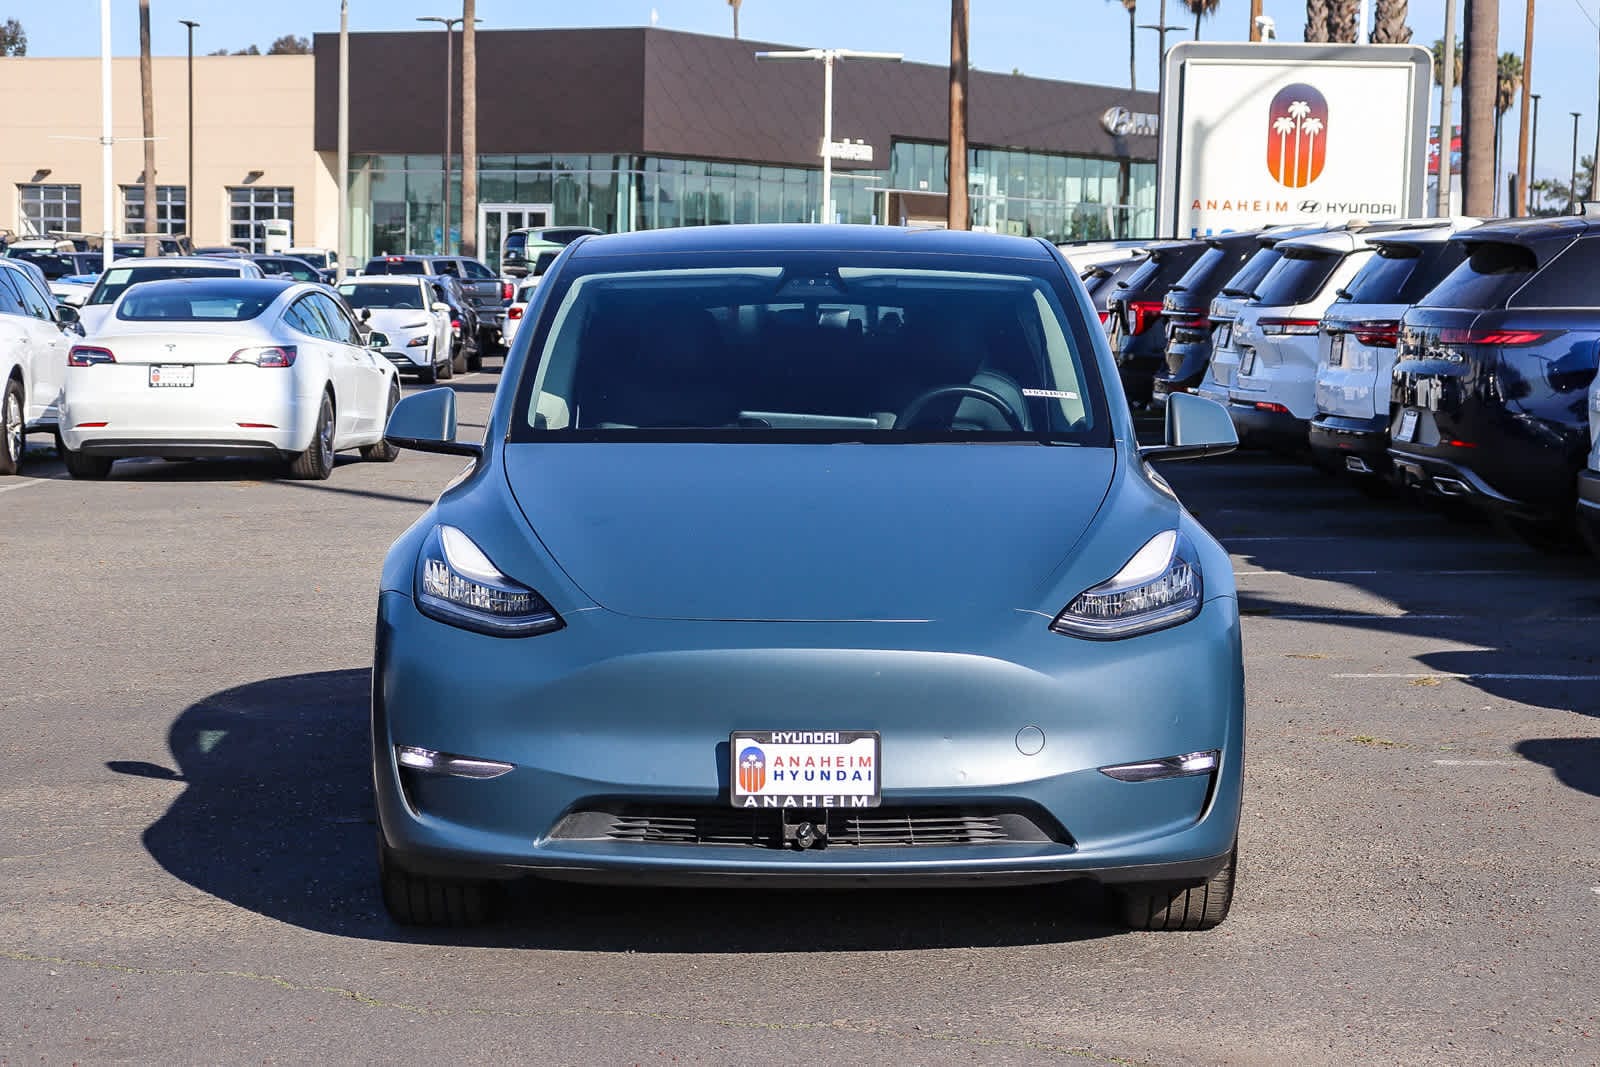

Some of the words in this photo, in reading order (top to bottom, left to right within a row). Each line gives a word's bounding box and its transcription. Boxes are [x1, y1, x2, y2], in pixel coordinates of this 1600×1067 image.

[1191, 199, 1288, 213] ANAHEIM
[1326, 202, 1396, 215] HYUNDAI
[772, 732, 840, 744] HYUNDAI
[774, 756, 872, 768] ANAHEIM
[774, 770, 872, 781] HYUNDAI
[744, 796, 868, 808] ANAHEIM
